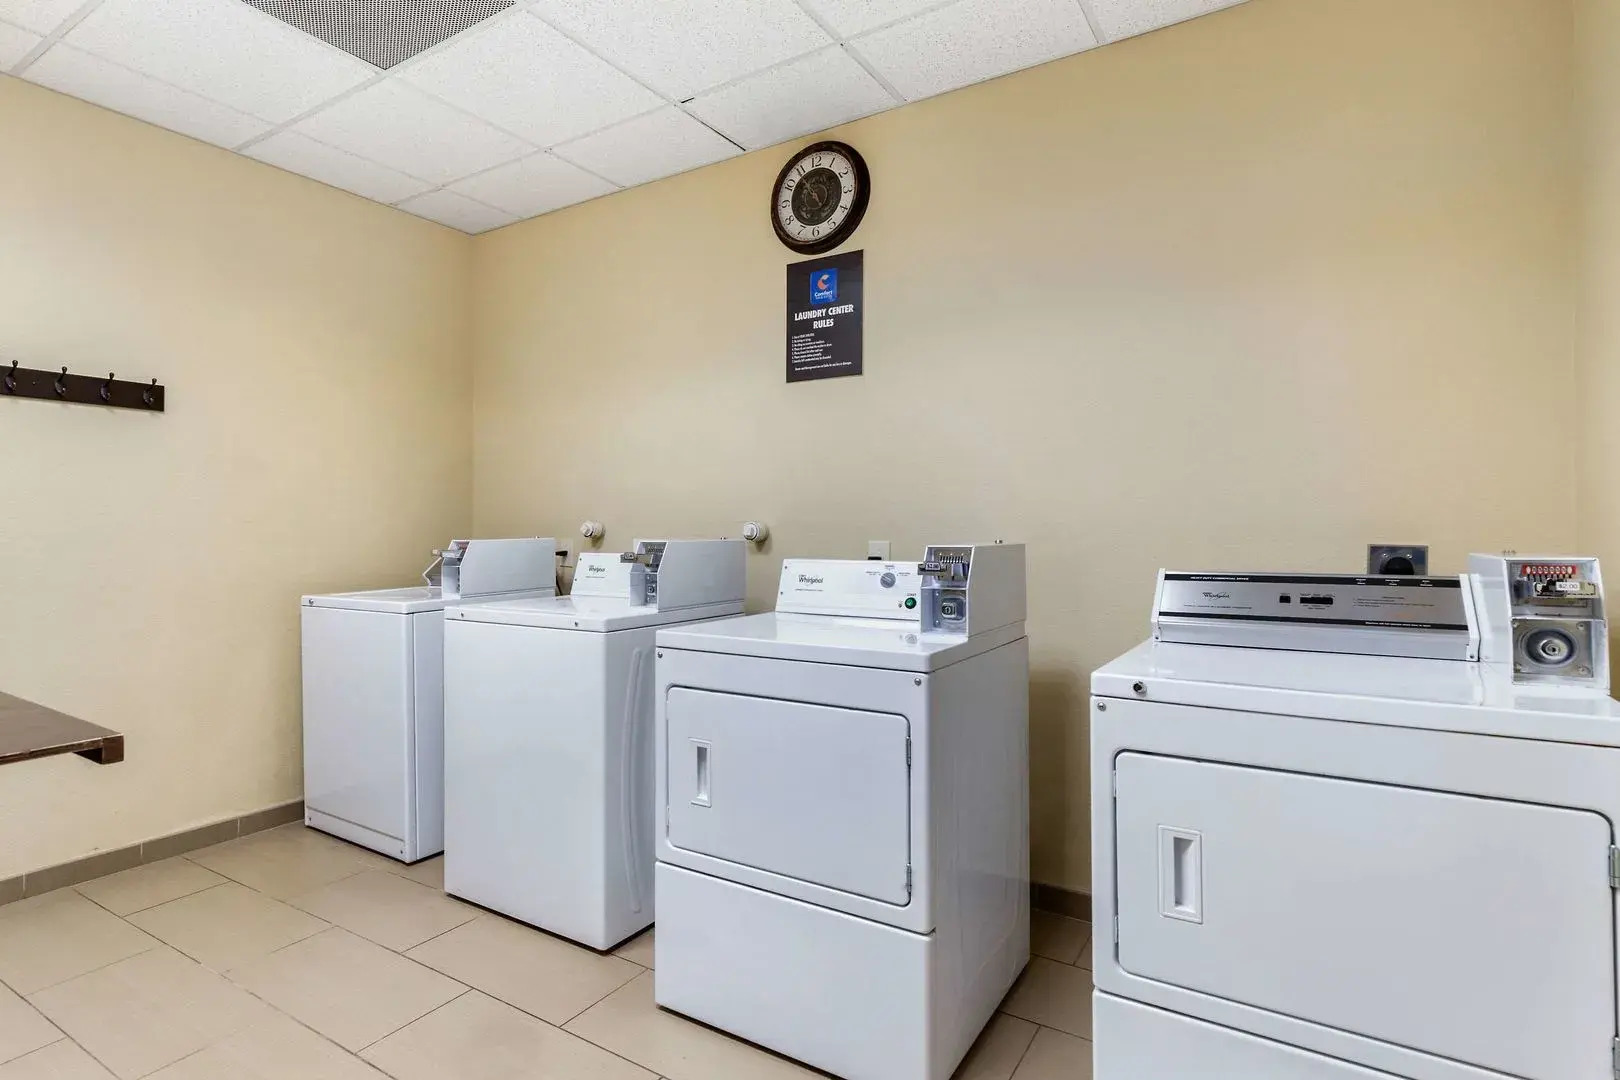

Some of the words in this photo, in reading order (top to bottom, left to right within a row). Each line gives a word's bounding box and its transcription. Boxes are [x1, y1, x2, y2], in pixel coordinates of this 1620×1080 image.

[811, 155, 822, 168] 12
[829, 157, 836, 168] 1
[796, 164, 806, 176] 11
[838, 167, 849, 178] 2
[784, 179, 795, 192] 10
[842, 184, 853, 194] 3
[781, 199, 791, 209] 9
[840, 203, 849, 213] 4
[784, 215, 795, 226] 8
[827, 218, 837, 230] 5
[797, 224, 806, 236] 7
[812, 226, 820, 238] 6
[794, 308, 827, 321] LAUNDRY
[828, 304, 854, 316] CENTER
[813, 318, 834, 329] RULES
[798, 574, 824, 584] Whirlpool
